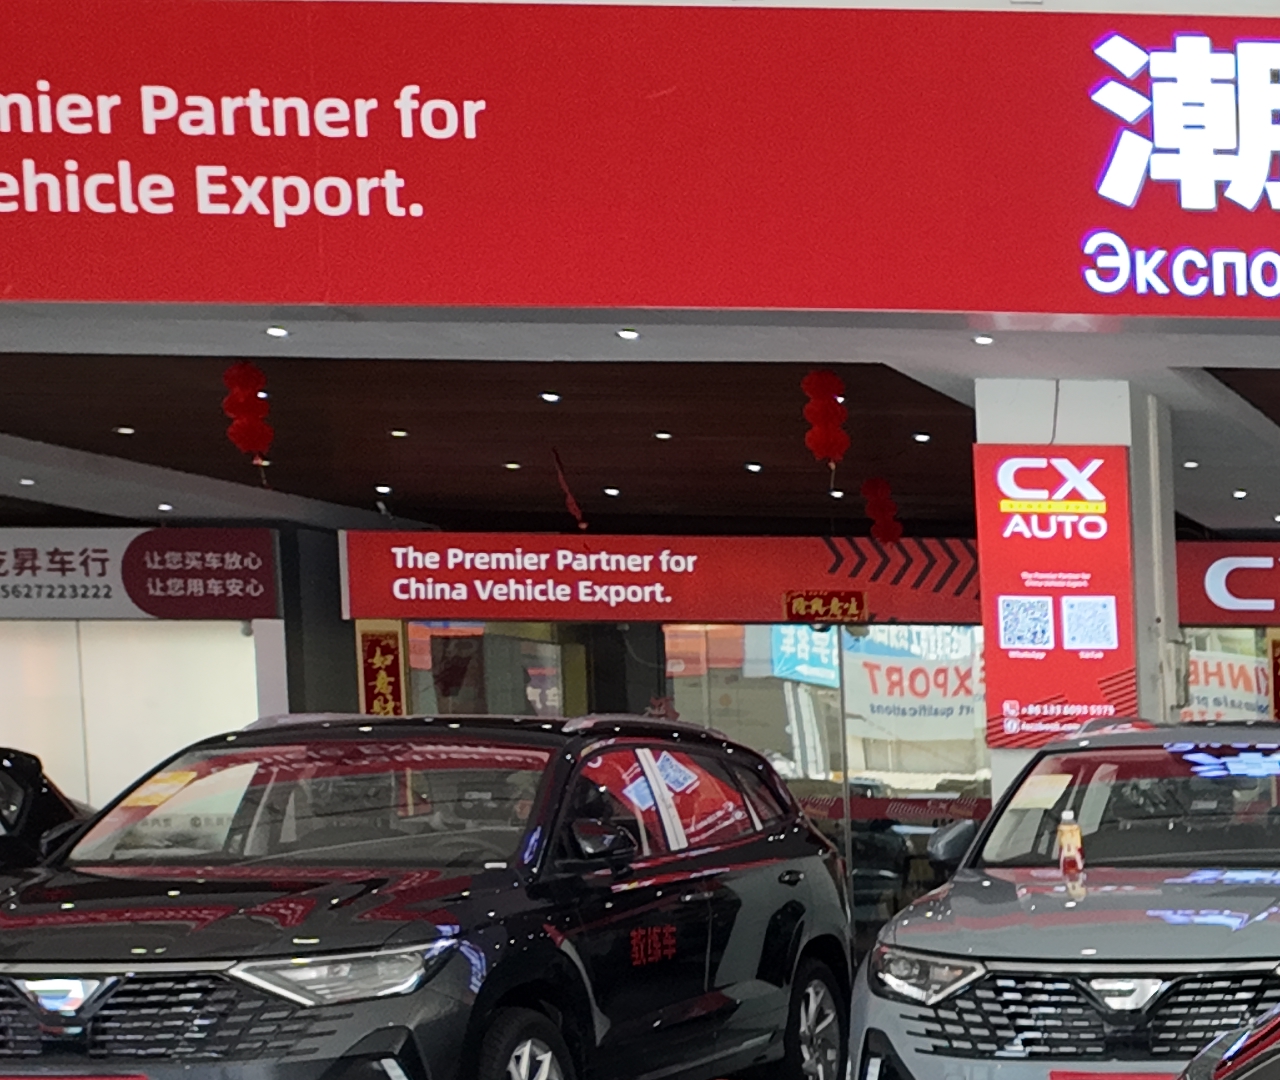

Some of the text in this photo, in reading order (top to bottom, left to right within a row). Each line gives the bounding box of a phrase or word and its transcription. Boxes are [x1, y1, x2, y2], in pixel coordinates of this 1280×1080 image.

[140, 85, 378, 137] Partner
[394, 85, 486, 139] for
[196, 165, 424, 228] Export.
[997, 457, 1106, 500] CX
[1002, 514, 1108, 539] AUTO
[144, 551, 263, 570] 让您买车放心
[391, 547, 698, 573] The Premier Partner for
[392, 577, 672, 607] China Vehicle Export.
